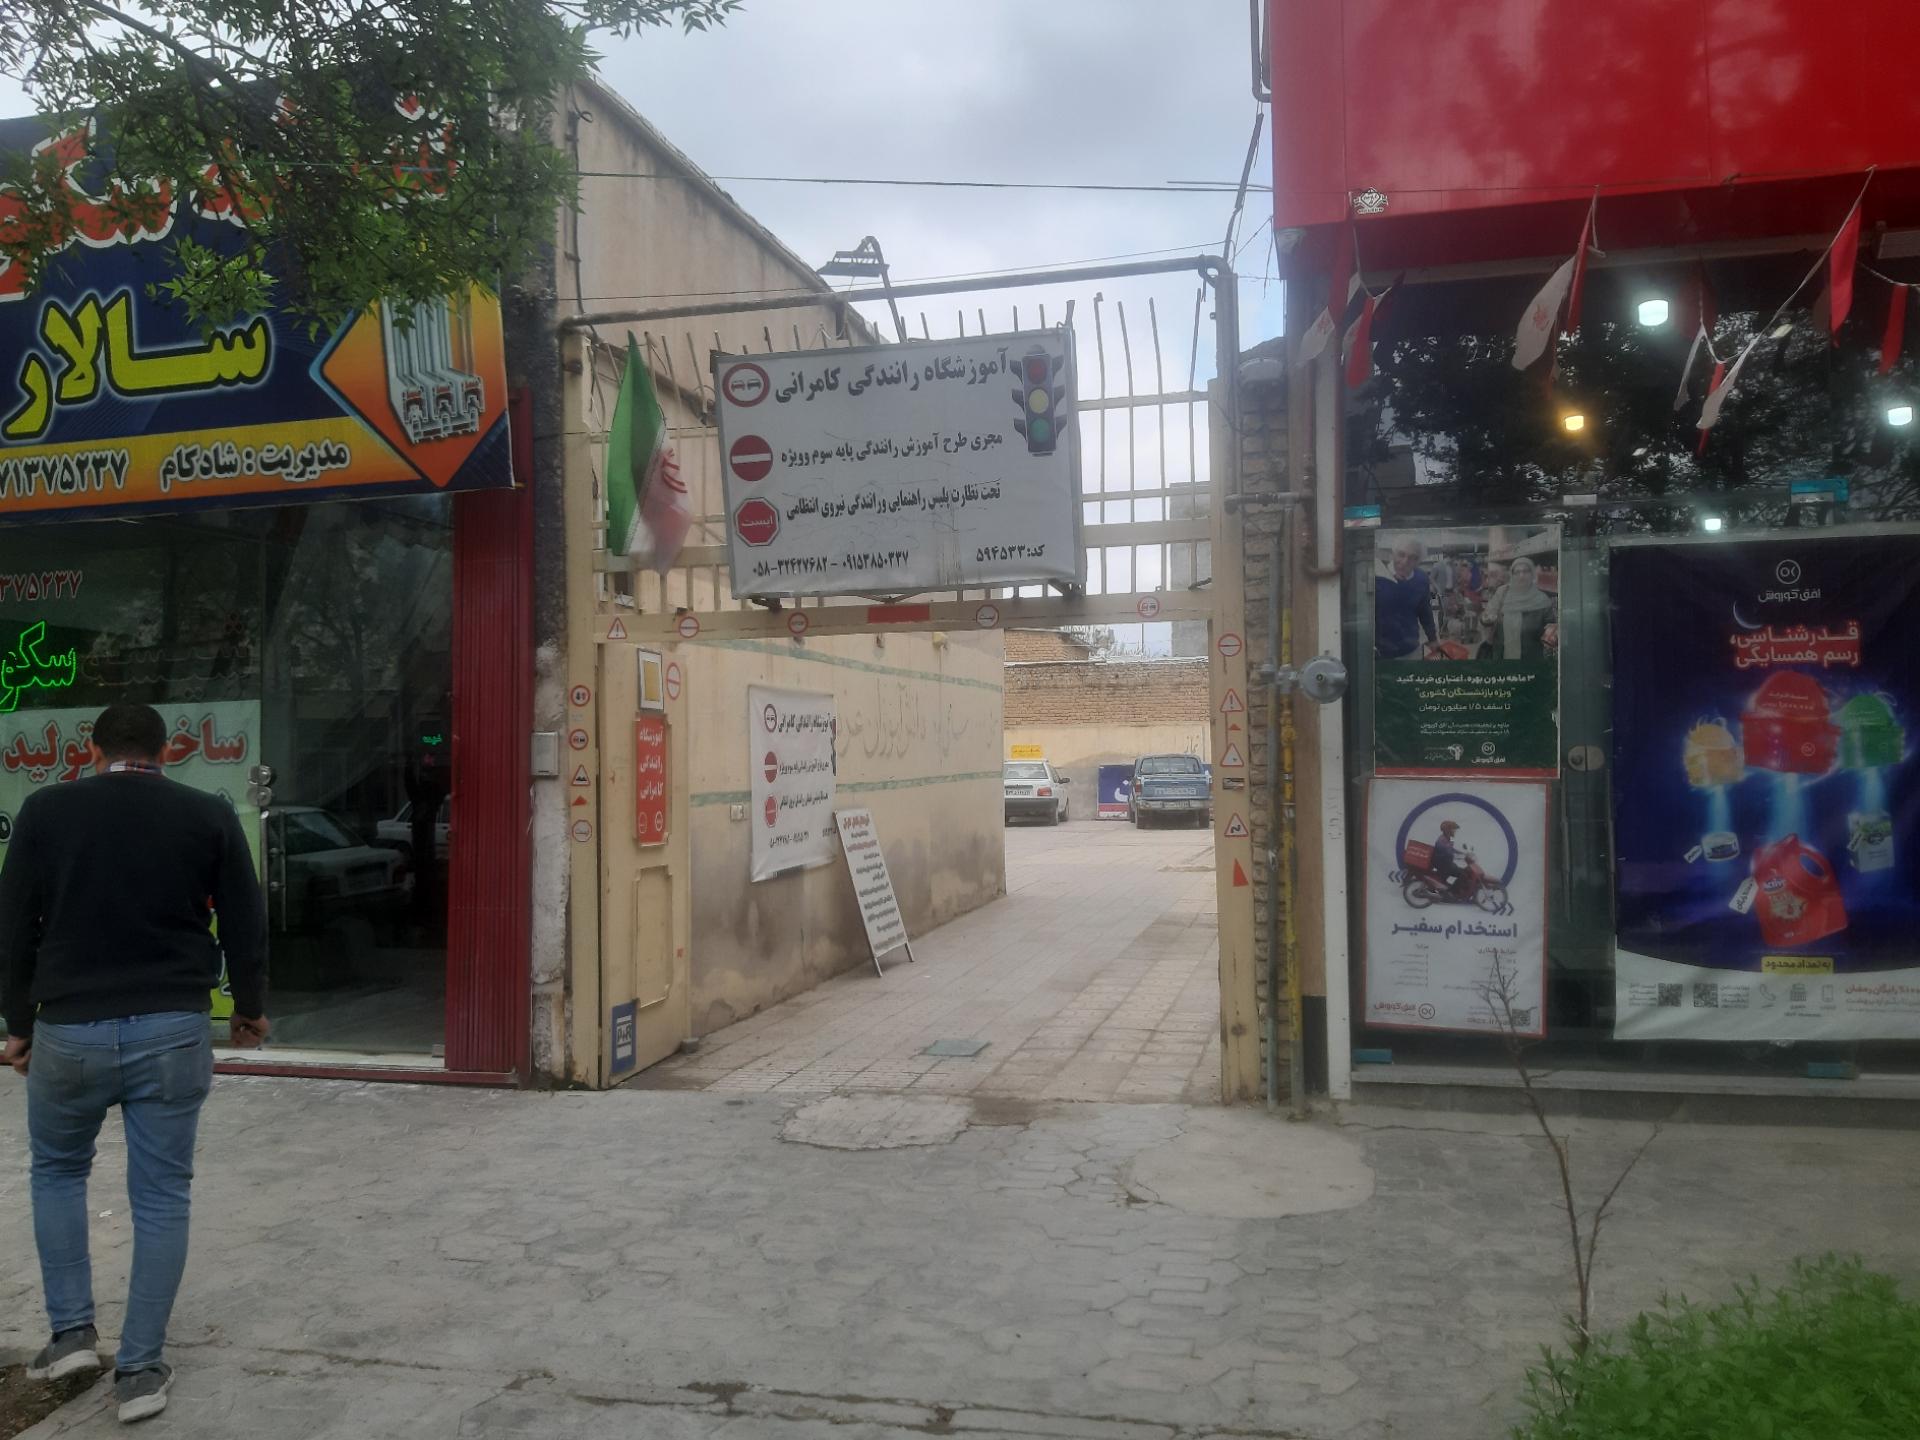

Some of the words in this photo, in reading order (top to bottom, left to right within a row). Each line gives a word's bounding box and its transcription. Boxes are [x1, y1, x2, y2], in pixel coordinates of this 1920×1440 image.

[3, 290, 271, 441] سالار
[925, 347, 1008, 385] آموزشگاه
[775, 367, 841, 403] کامرانی
[848, 360, 920, 396] رانندگی
[856, 439, 899, 461] رانندگی
[902, 433, 939, 457] آموزش
[943, 432, 967, 453] طرح
[970, 433, 1003, 451] مجری
[812, 450, 832, 465] سوم
[889, 489, 926, 514] راهنمایی
[927, 487, 950, 511] پلیس
[951, 484, 979, 507] نظارت
[981, 485, 1001, 501] تحت
[787, 497, 819, 520] انتظامی
[821, 495, 845, 518] نیروی
[742, 515, 773, 528] ایست
[1758, 589, 1800, 604] کوروش
[1799, 589, 1821, 602] افق
[1736, 645, 1819, 668] همسایگی
[1823, 649, 1859, 668] رسم
[1391, 917, 1443, 937] سفیر
[1445, 919, 1518, 940] استخدام
